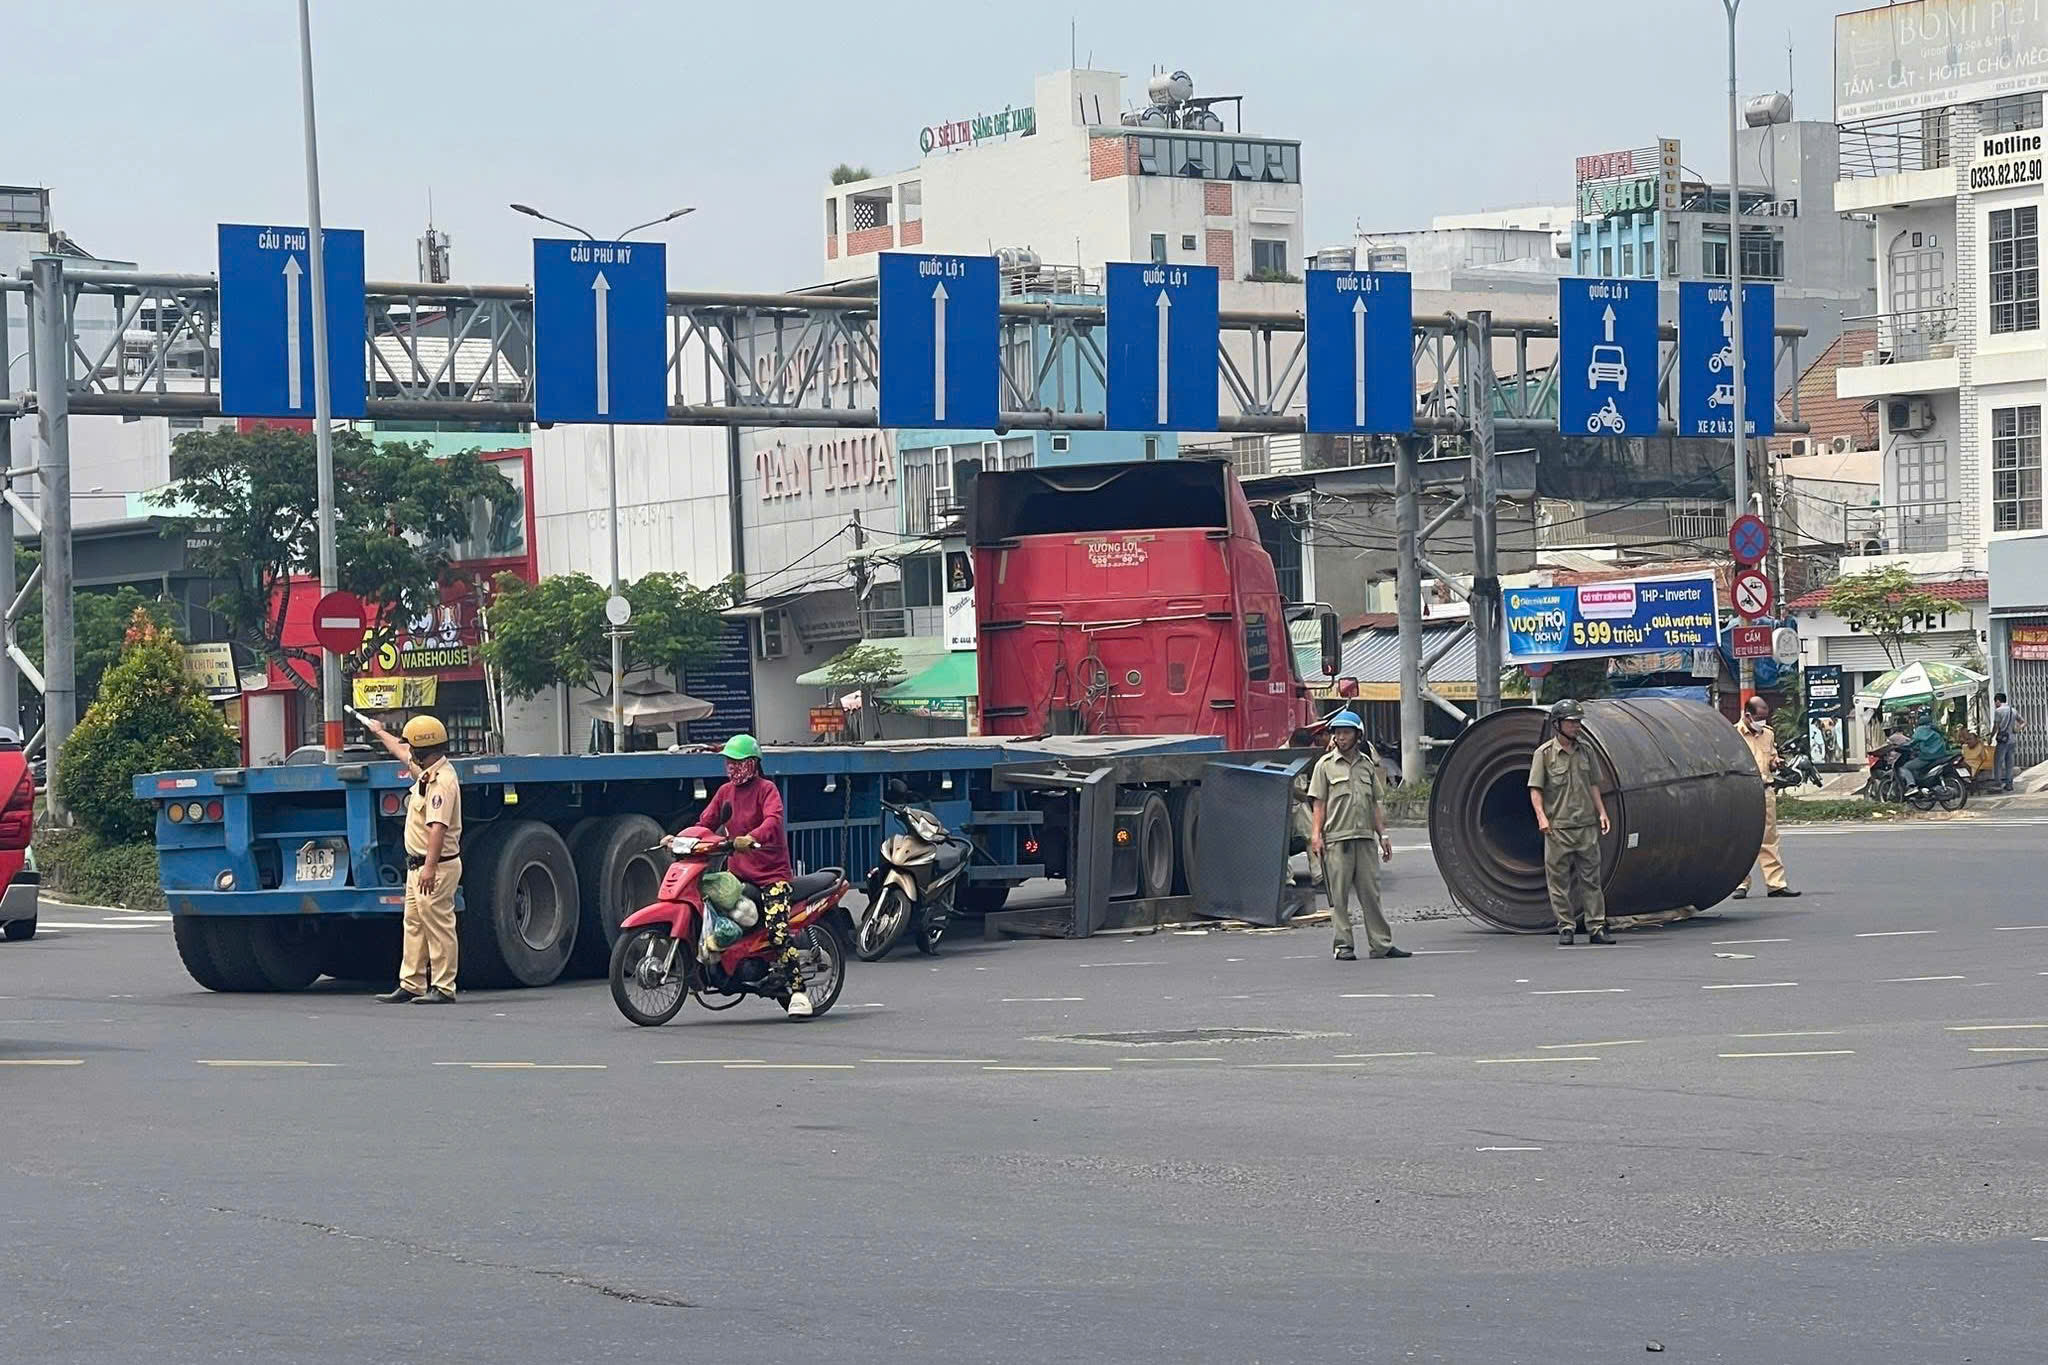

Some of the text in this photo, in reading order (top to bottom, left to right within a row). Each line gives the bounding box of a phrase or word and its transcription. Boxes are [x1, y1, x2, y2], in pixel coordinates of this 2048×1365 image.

[1929, 61, 1974, 83] HOTEL
[1984, 136, 2041, 157] Hotline
[1577, 151, 1635, 180] HOTEL
[1971, 159, 2042, 189] 0333.82.82.90
[258, 227, 280, 250] CẦU
[284, 231, 306, 250] PHÚ
[570, 241, 632, 264] CẦU PHÚ MỸ
[919, 255, 965, 280] QUỐC LỘ 1
[1143, 264, 1188, 289] QUỐC LỘ 1
[1336, 272, 1380, 294] QUỐC LỘ 1
[1588, 280, 1629, 301] QUỐC LỘ 1
[1707, 285, 1728, 304] QUỐC
[1697, 420, 1708, 433] XE
[1709, 420, 1716, 433] 2
[1717, 416, 1727, 433] VÀ
[1728, 420, 1734, 433] 3
[1640, 589, 1659, 602] 1HP
[1665, 588, 1701, 601] Inverter
[1651, 613, 1671, 629] QUÀ
[1695, 613, 1712, 629] trội
[1573, 621, 1611, 648] 5,99
[1613, 627, 1643, 648] triệu
[1680, 630, 1701, 646] triệu
[1744, 629, 1761, 643] CẤM
[400, 648, 468, 669] WAREHOUSE
